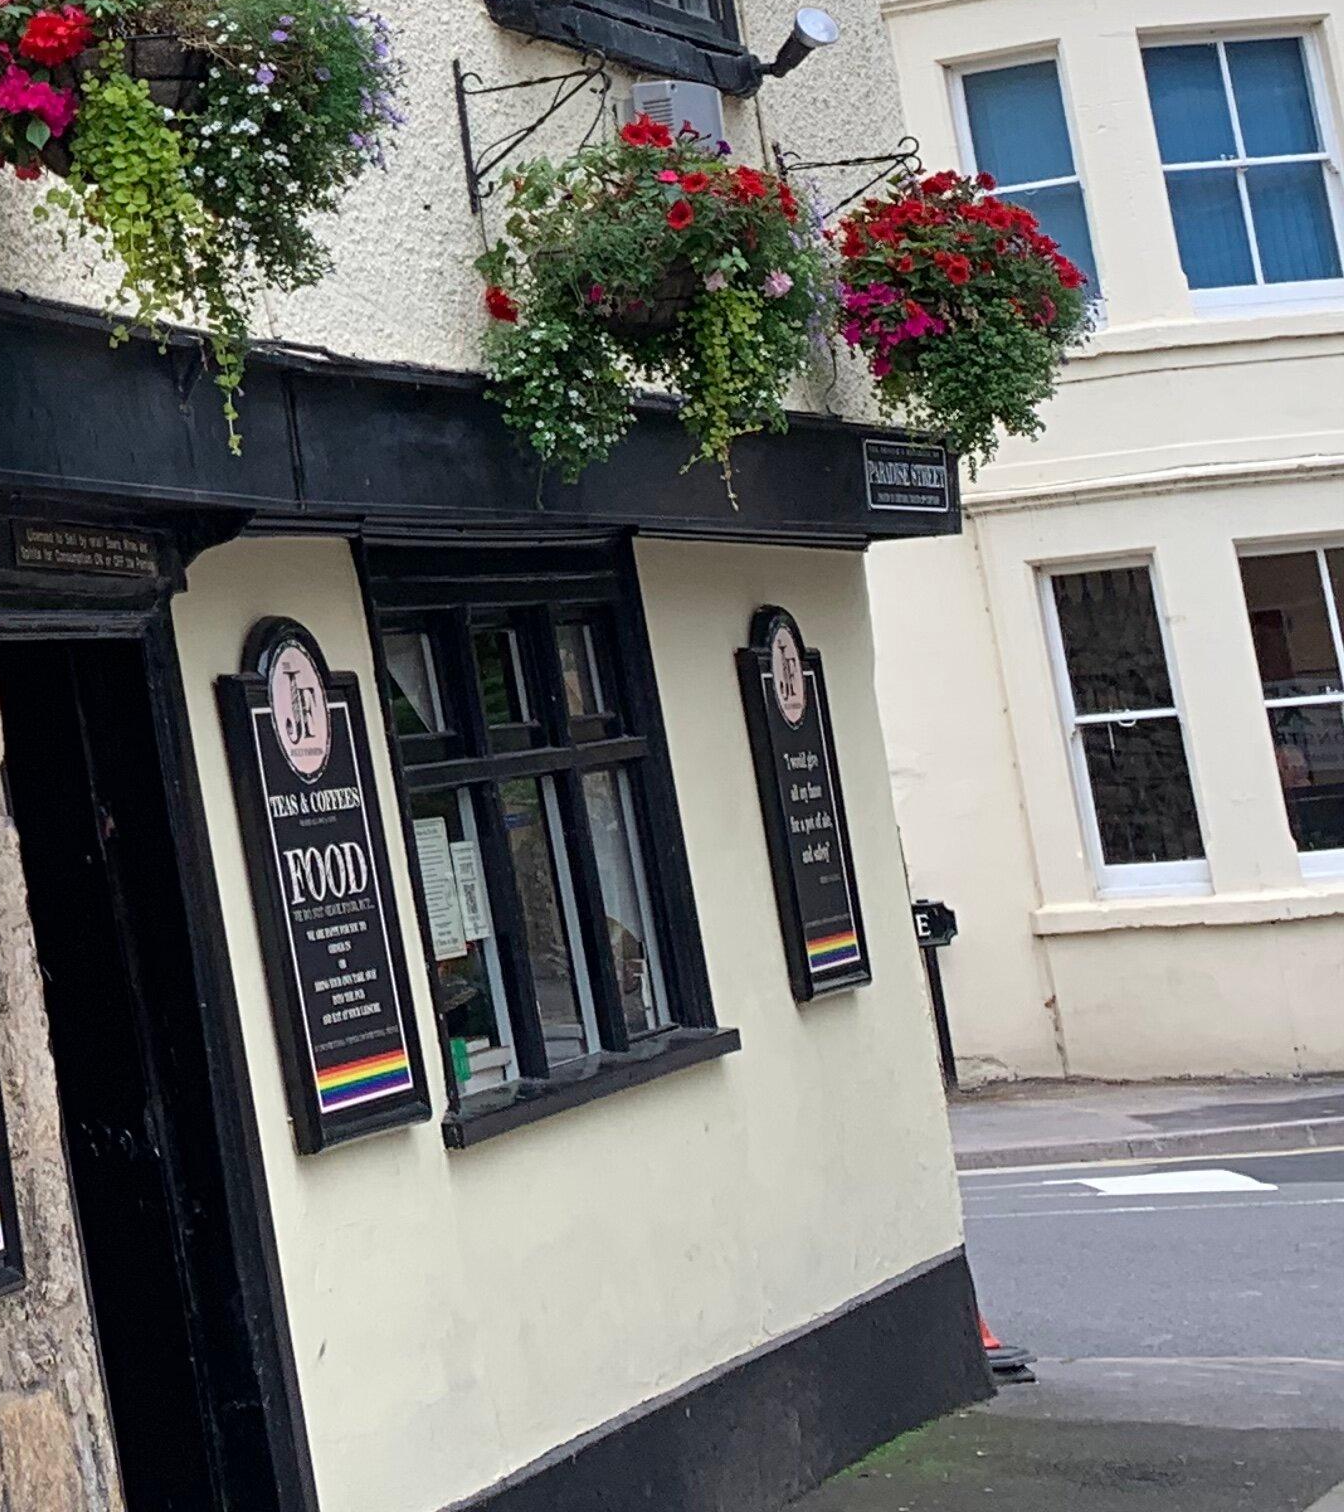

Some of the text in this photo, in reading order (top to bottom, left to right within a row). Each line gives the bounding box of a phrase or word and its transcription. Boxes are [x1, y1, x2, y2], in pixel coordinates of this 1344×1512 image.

[269, 787, 360, 818] TEAS & COFFEES
[283, 841, 368, 905] FOOD
